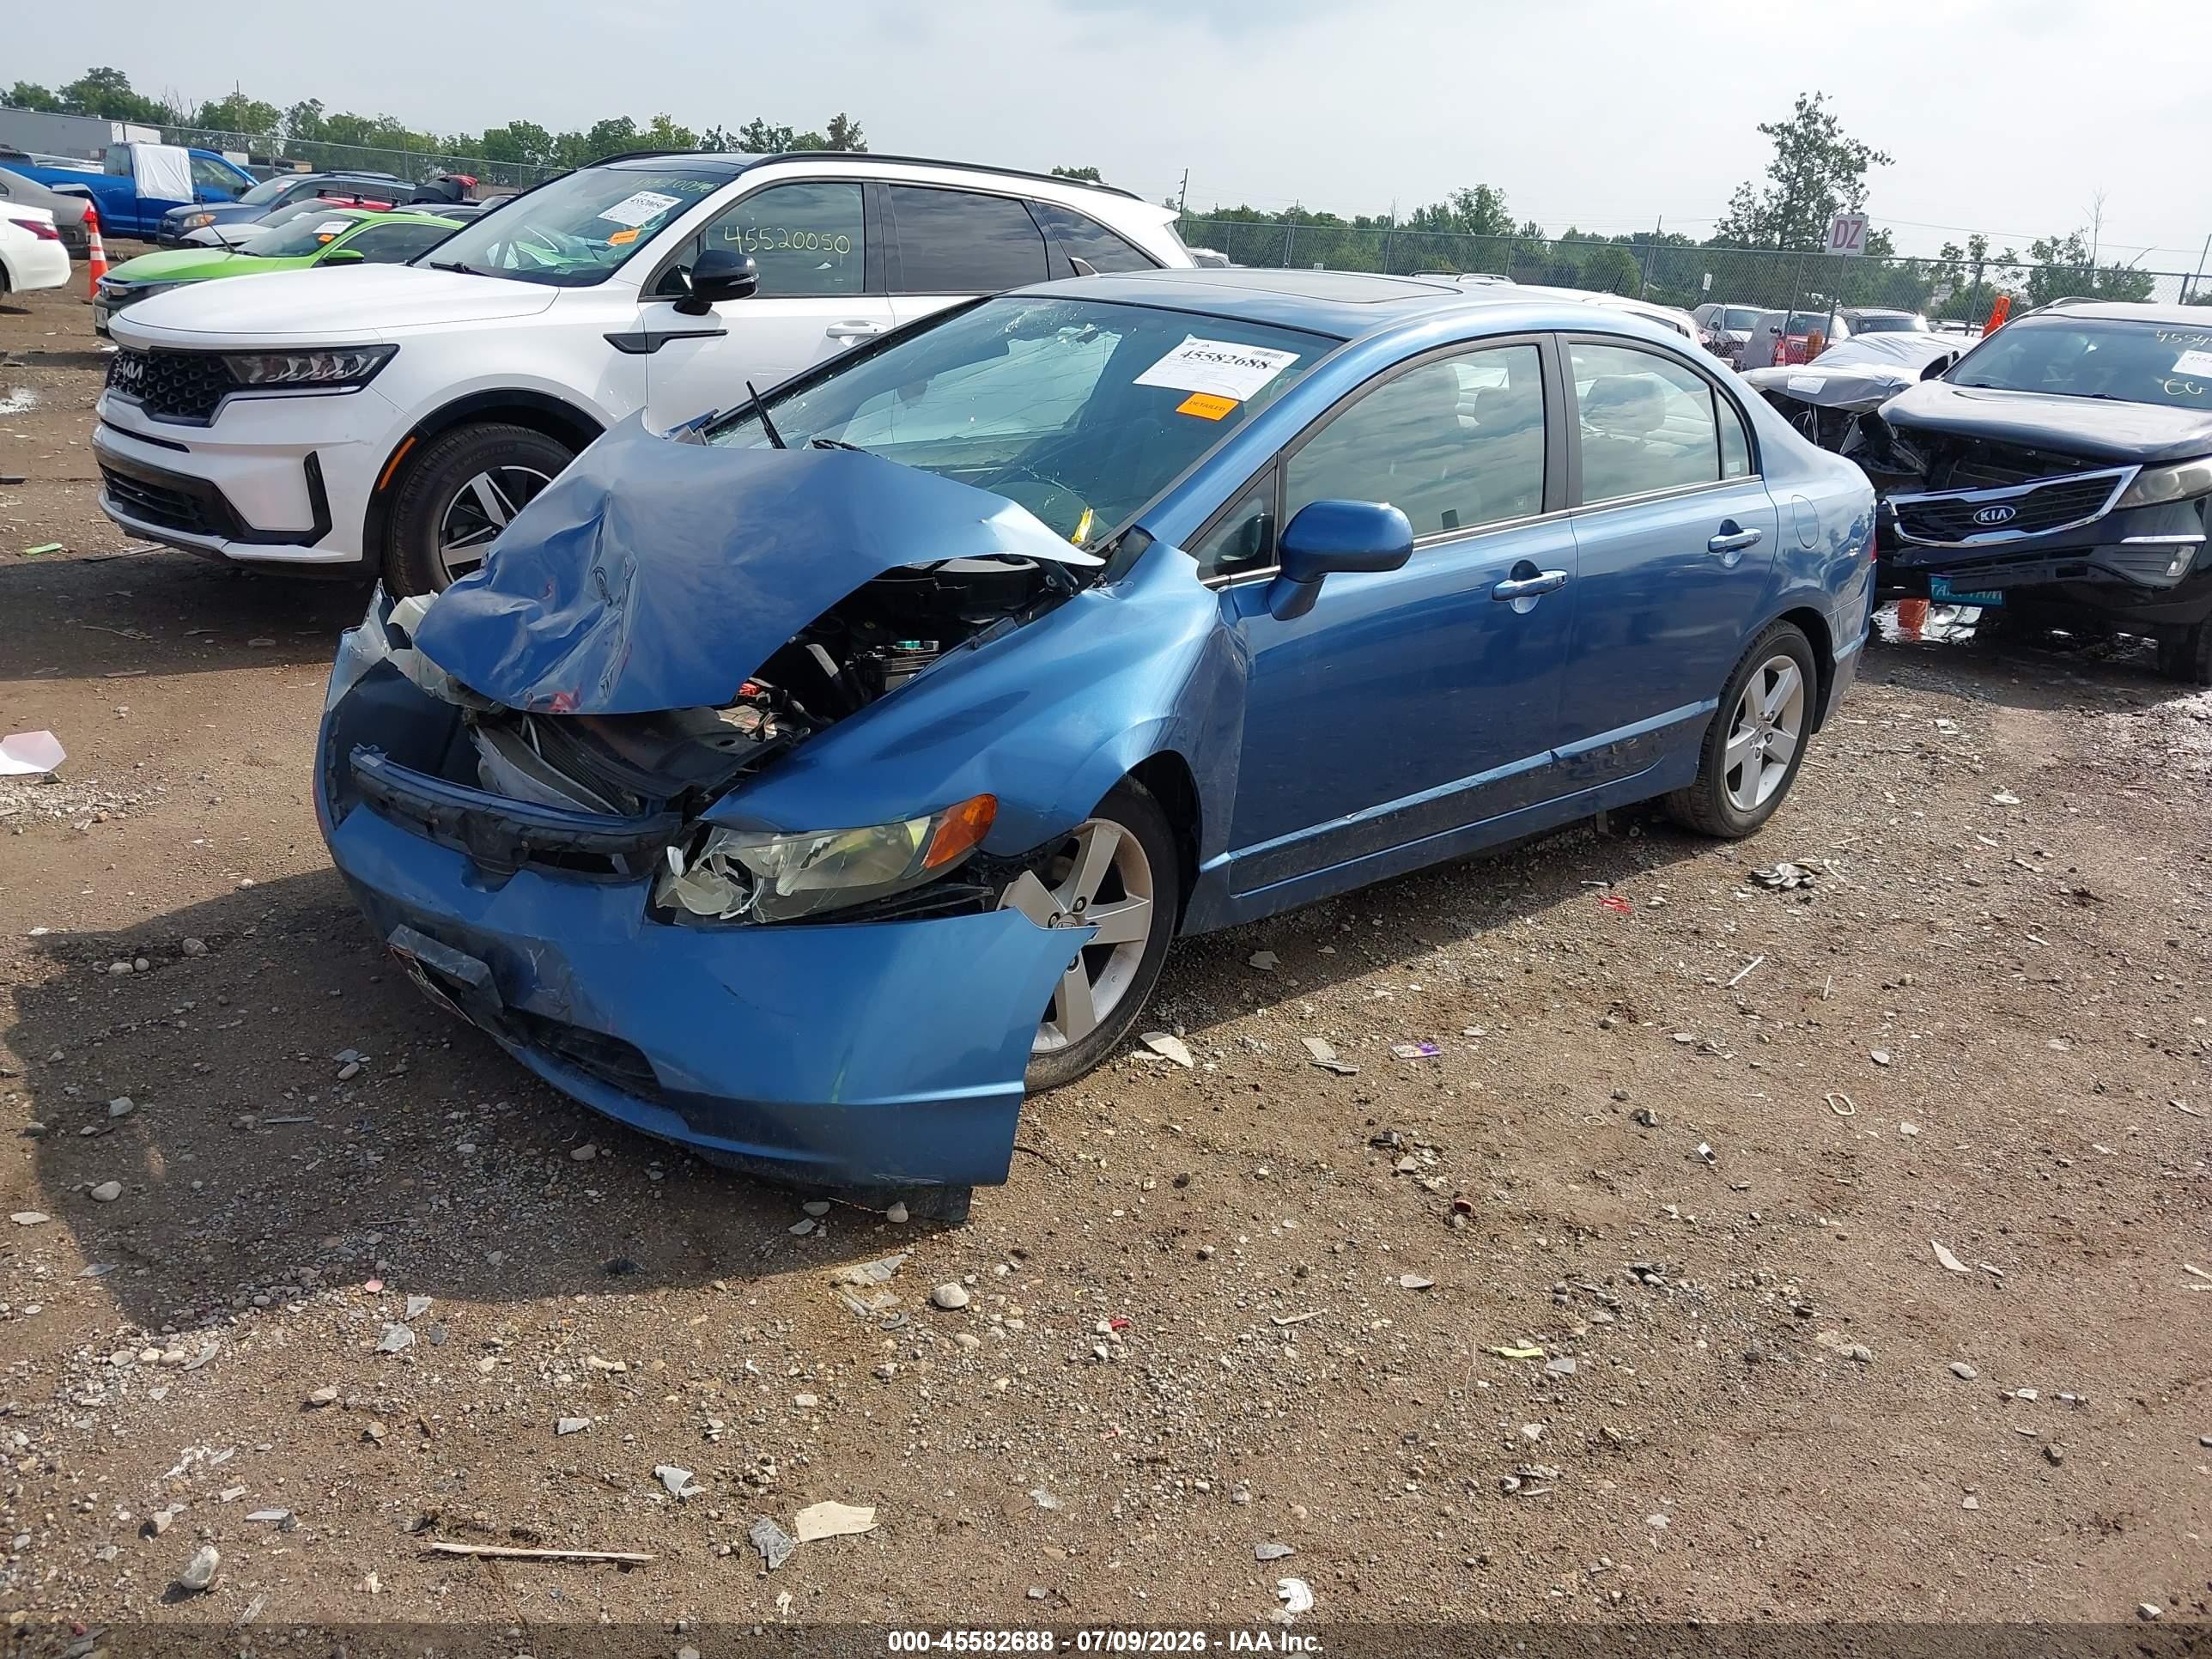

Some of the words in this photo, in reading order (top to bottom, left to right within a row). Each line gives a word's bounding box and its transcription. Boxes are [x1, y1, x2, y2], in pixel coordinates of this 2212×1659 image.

[724, 226, 851, 255] 45520050
[1831, 219, 1863, 249] DZ
[1180, 349, 1272, 370] 45582688
[1188, 399, 1226, 412] DETAILED
[1980, 508, 2008, 521] KIA
